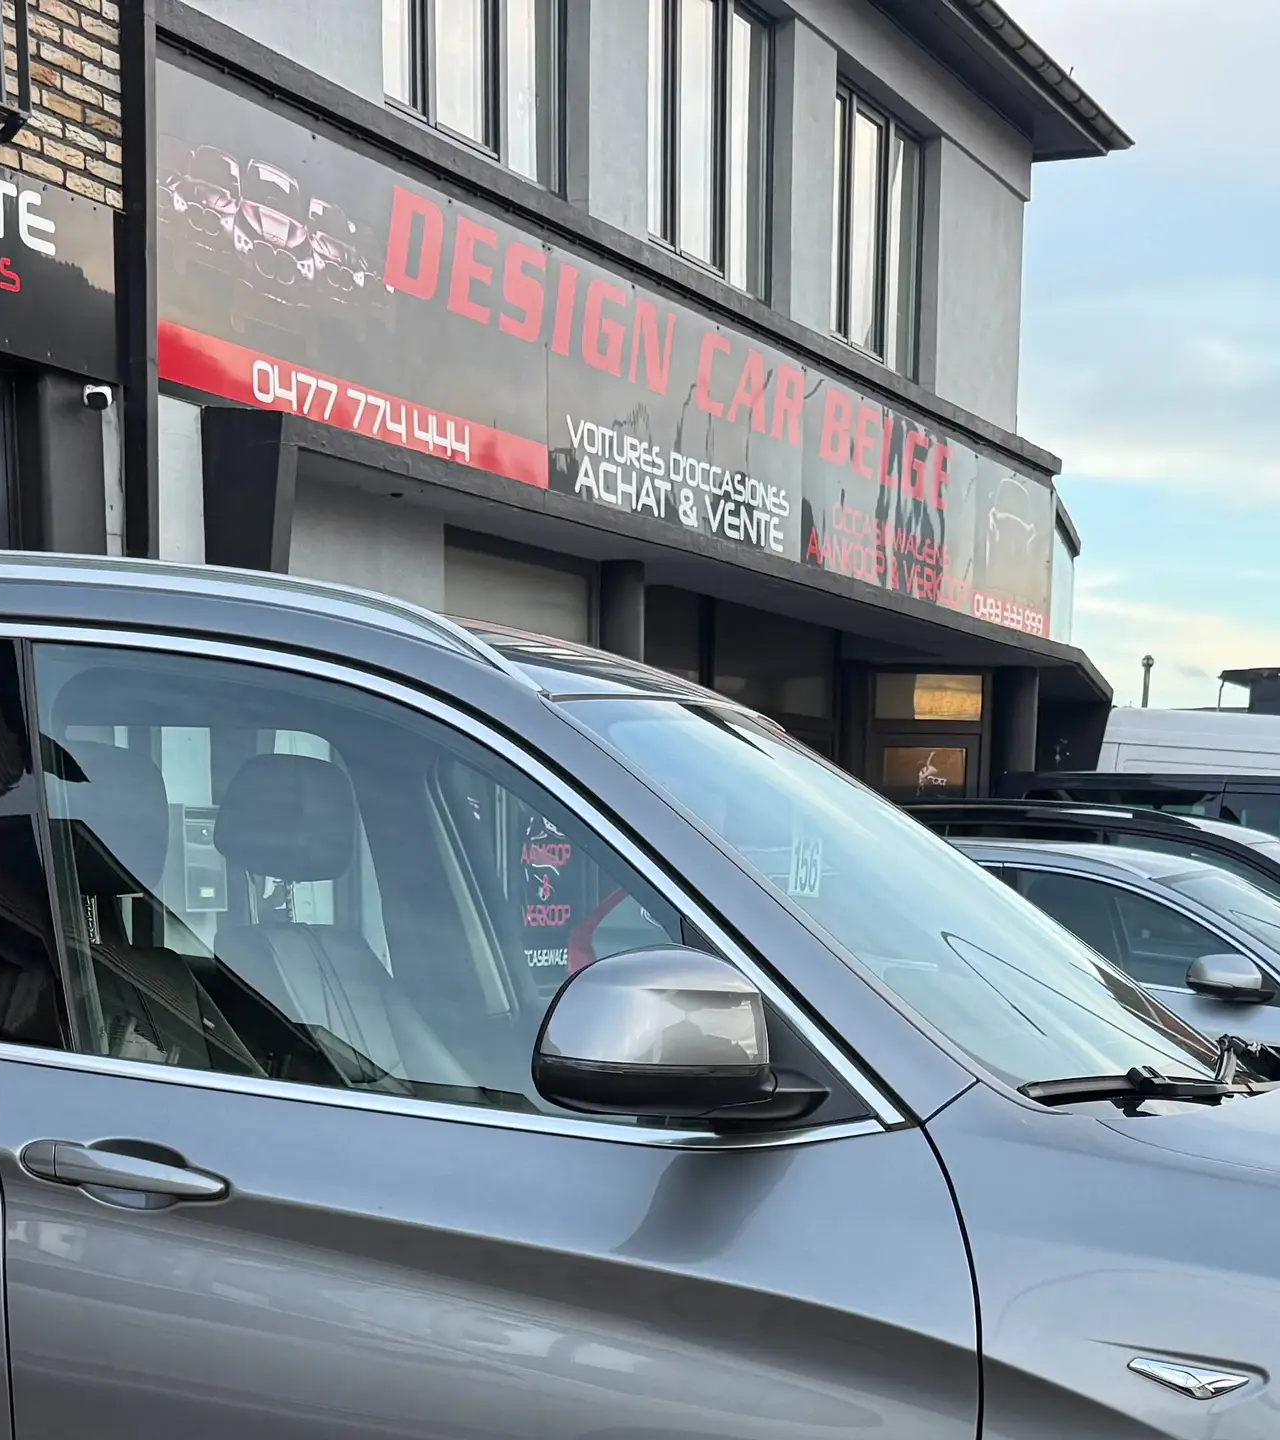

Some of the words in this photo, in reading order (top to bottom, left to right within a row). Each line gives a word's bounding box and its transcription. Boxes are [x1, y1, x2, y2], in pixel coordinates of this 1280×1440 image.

[383, 184, 677, 396] DESIGN
[695, 330, 806, 447] CAR
[818, 387, 953, 511] BELGE
[252, 360, 338, 420] 0477
[346, 388, 407, 444] 774
[413, 409, 470, 463] 444
[566, 414, 665, 476] VOITURES
[669, 451, 790, 517] D'OCCASIONES
[574, 455, 671, 519] ACHAT
[678, 488, 698, 528] &
[705, 495, 784, 552] VENTE
[806, 527, 885, 583] AANKOOP
[902, 559, 969, 610] VERKOOP
[832, 501, 951, 569] OCCASIWAGENS
[794, 839, 819, 893] 156
